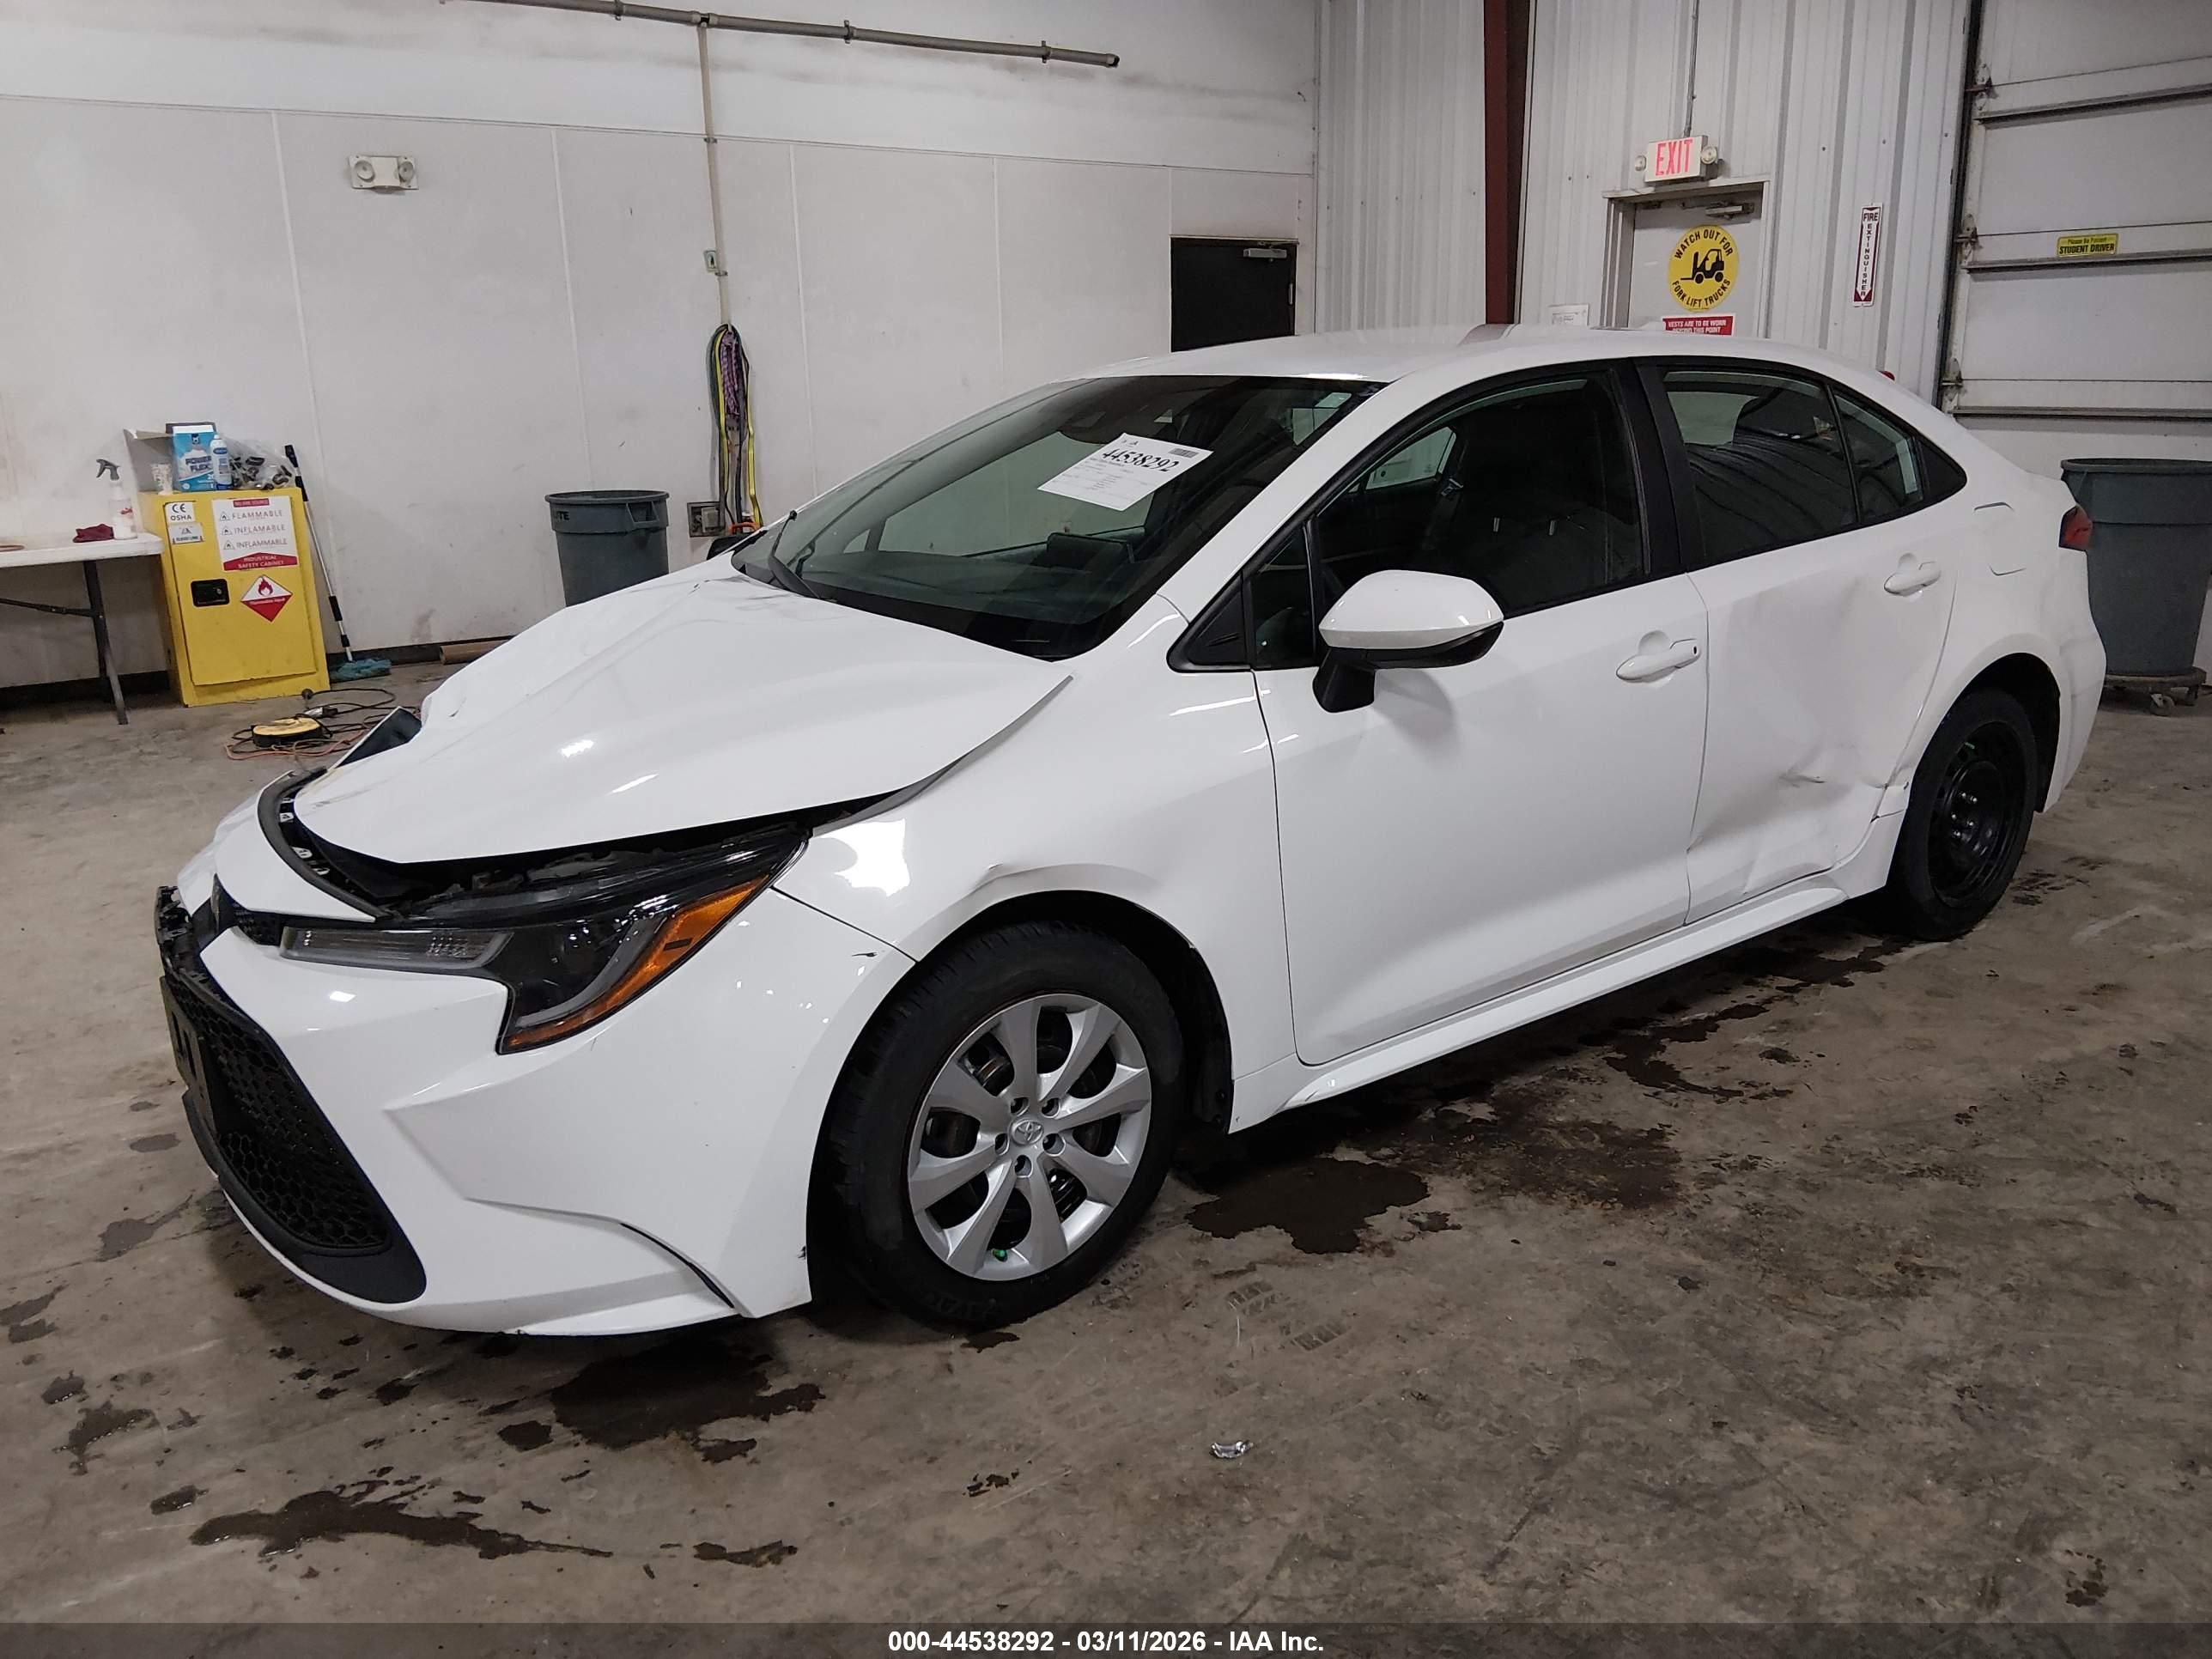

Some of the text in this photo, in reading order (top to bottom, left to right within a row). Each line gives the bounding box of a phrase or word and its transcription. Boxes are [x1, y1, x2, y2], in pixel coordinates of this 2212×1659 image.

[1655, 138, 1693, 177] EXIT
[1863, 212, 1879, 222] FIRE
[1674, 228, 1734, 259] WATCH OUT FOR
[2059, 243, 2115, 255] STUDENT DRIVER
[1860, 222, 1873, 295] EXTINGUISHER
[1672, 279, 1731, 307] FORK LIFT TRUCKS
[1103, 448, 1180, 472] 44538292
[233, 510, 283, 521] FLAMMABLE
[234, 525, 286, 537] INFLAMABLE
[237, 539, 288, 551] INFLAMMABLE
[259, 560, 284, 568] CABINET
